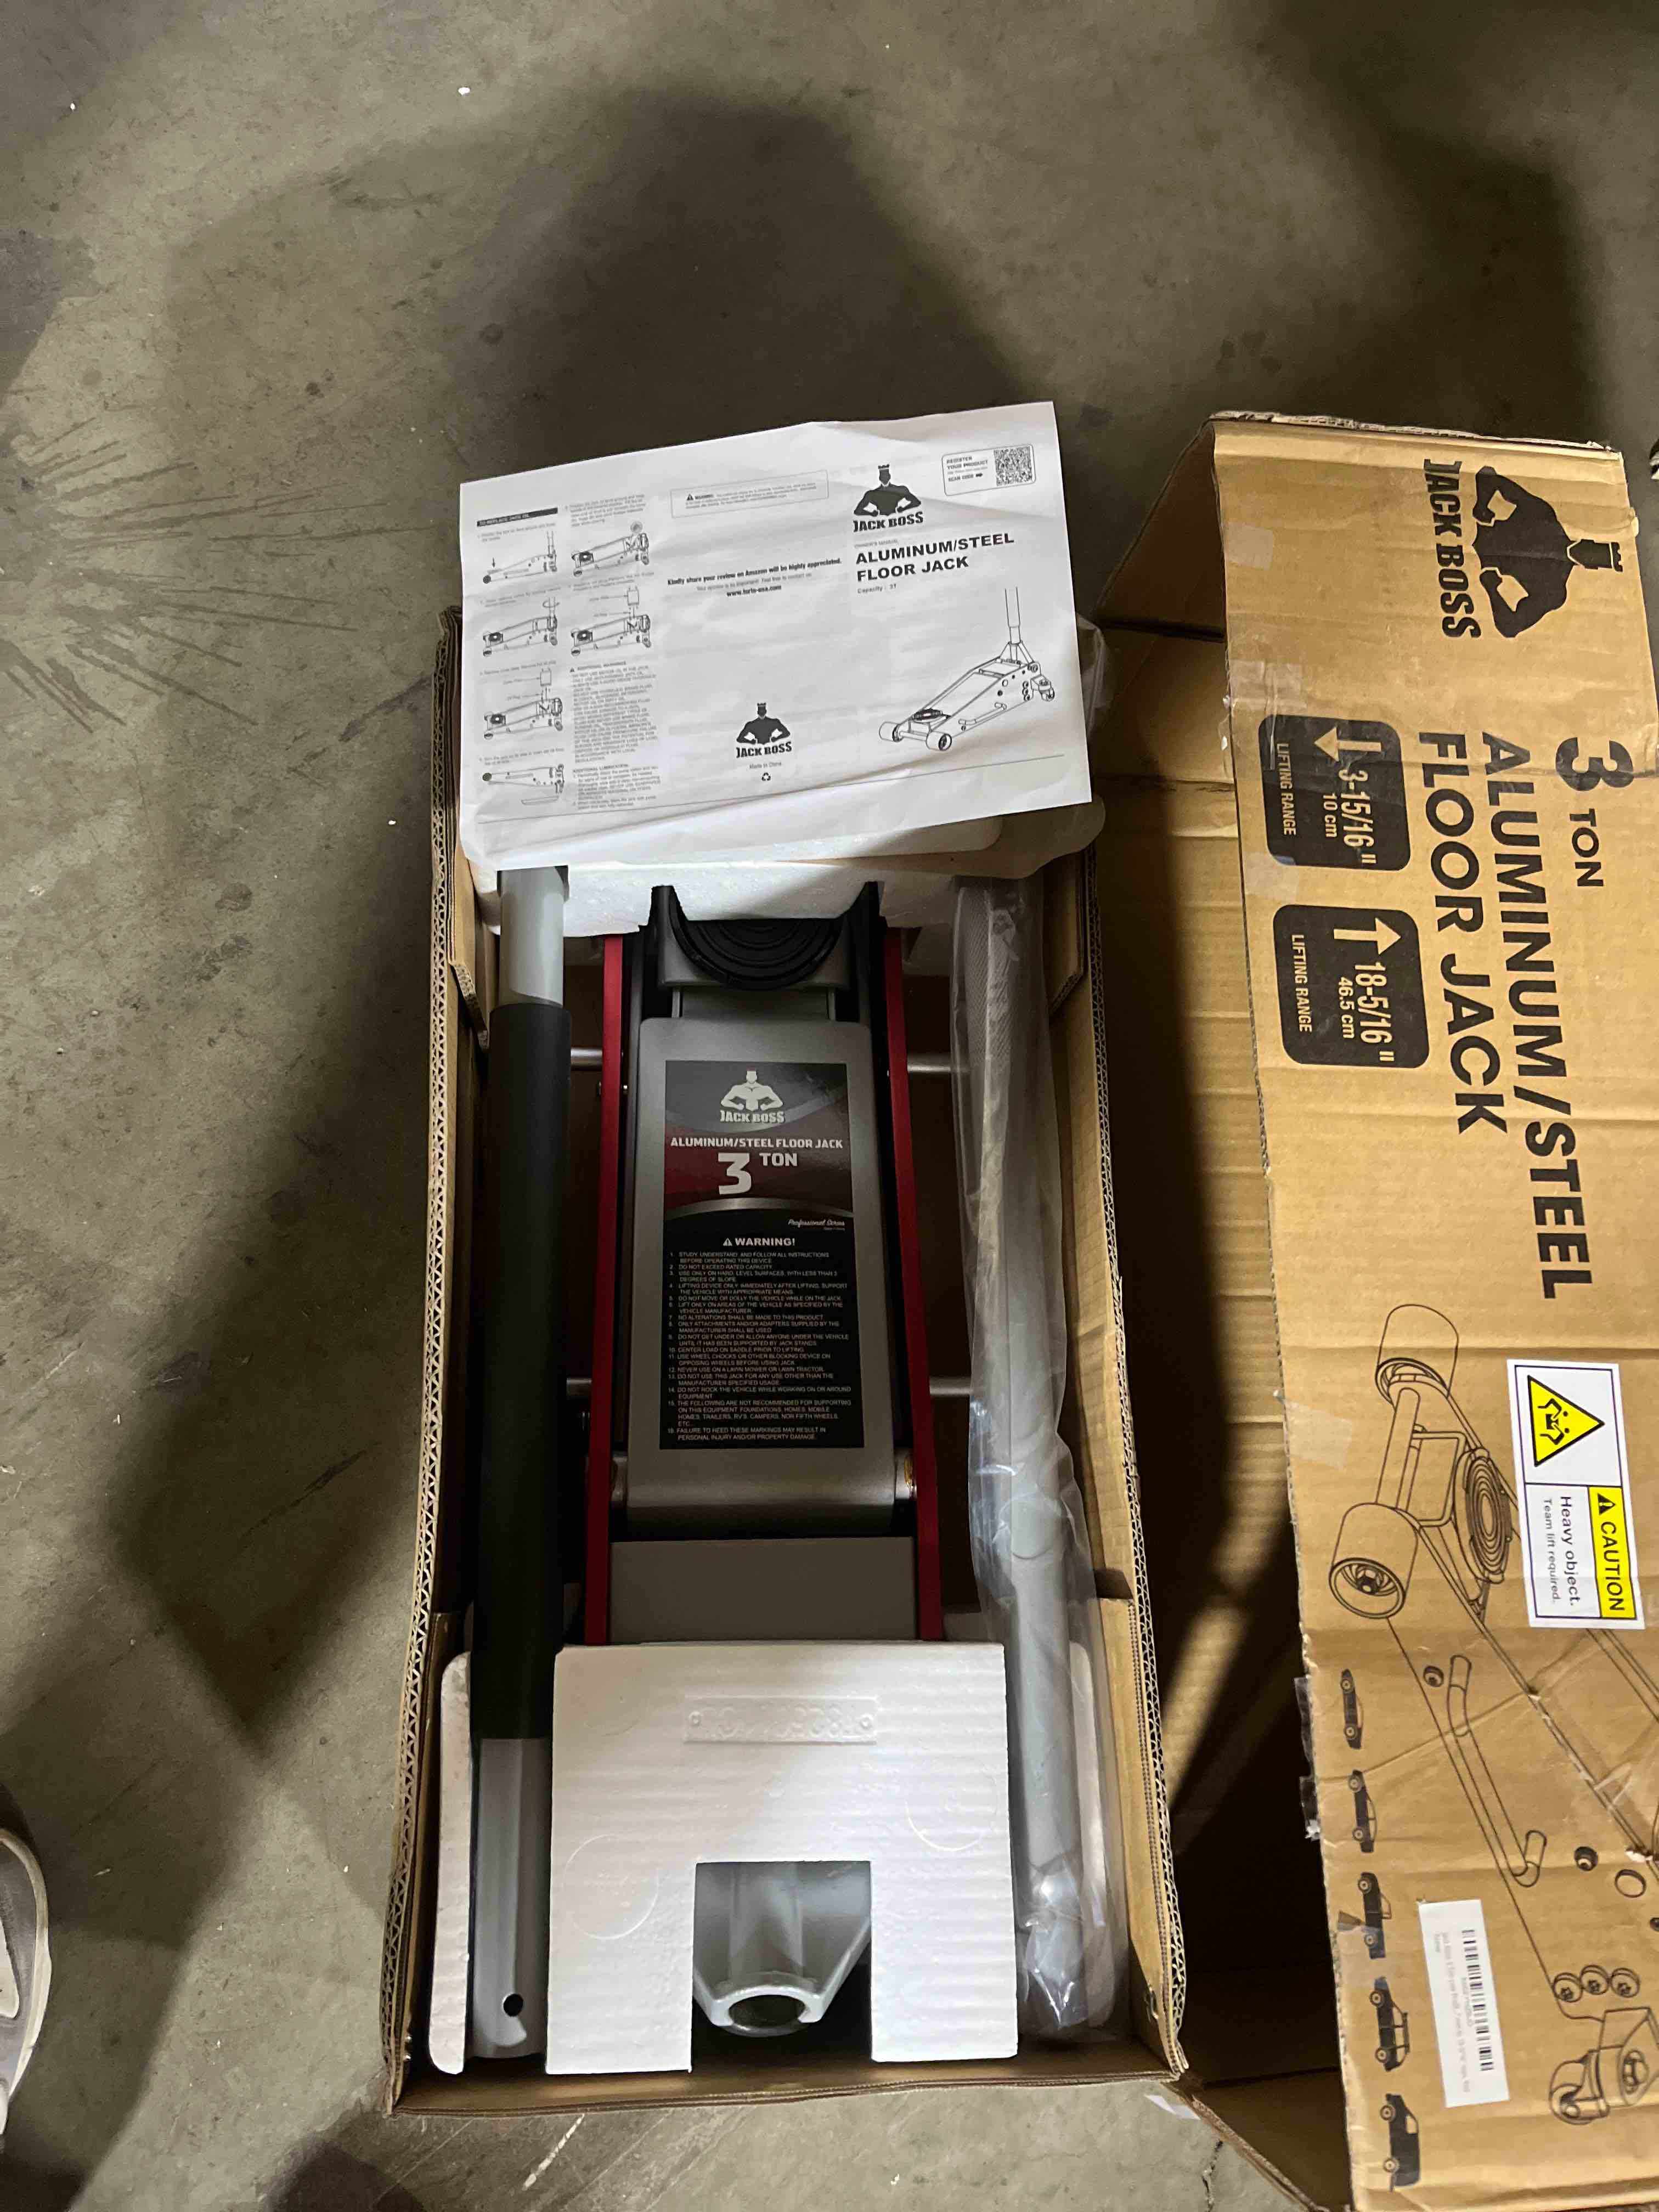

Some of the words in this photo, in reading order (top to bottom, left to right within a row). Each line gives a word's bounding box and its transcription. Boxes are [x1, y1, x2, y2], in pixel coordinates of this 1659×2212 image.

[1424, 459, 1462, 537] JACK
[853, 520, 885, 532] JACK
[888, 511, 924, 527] BOSS
[856, 533, 1014, 564] ALUMINUM/STEEL
[857, 564, 916, 582] FLOOR
[921, 556, 969, 573] JACK
[1436, 543, 1481, 638] BOSS
[736, 747, 762, 758] JACK
[764, 742, 792, 755] BOSS
[1277, 743, 1292, 789] LIFTING
[1555, 737, 1634, 791] 3
[1281, 793, 1296, 836] RANGE
[1323, 793, 1338, 811] 10
[1324, 815, 1338, 837] cm
[1419, 732, 1483, 933] FLOOR
[1570, 808, 1604, 887] TON
[1291, 935, 1308, 984] LIFTING
[1295, 988, 1312, 1032] RANGE
[1338, 977, 1355, 1010] 46.5
[1341, 1014, 1355, 1039] cm
[1482, 732, 1592, 1299] ALUMINUM/STEEL
[1441, 953, 1508, 1134] JACK
[720, 1110, 749, 1122] JACK
[752, 1110, 785, 1123] BOSS
[670, 1137, 774, 1148] ALUMINUM/STEEL
[776, 1138, 812, 1148] FLOOR
[815, 1139, 843, 1149] JACK
[718, 1153, 752, 1195] 3
[759, 1153, 798, 1166] TON
[735, 1238, 795, 1246] WARNING!
[1544, 1498, 1553, 1530] Team
[1560, 1496, 1573, 1545] Heavy
[1546, 1533, 1555, 1548] lift
[1564, 1550, 1581, 1606] object.
[1601, 1521, 1625, 1611] CAUTION
